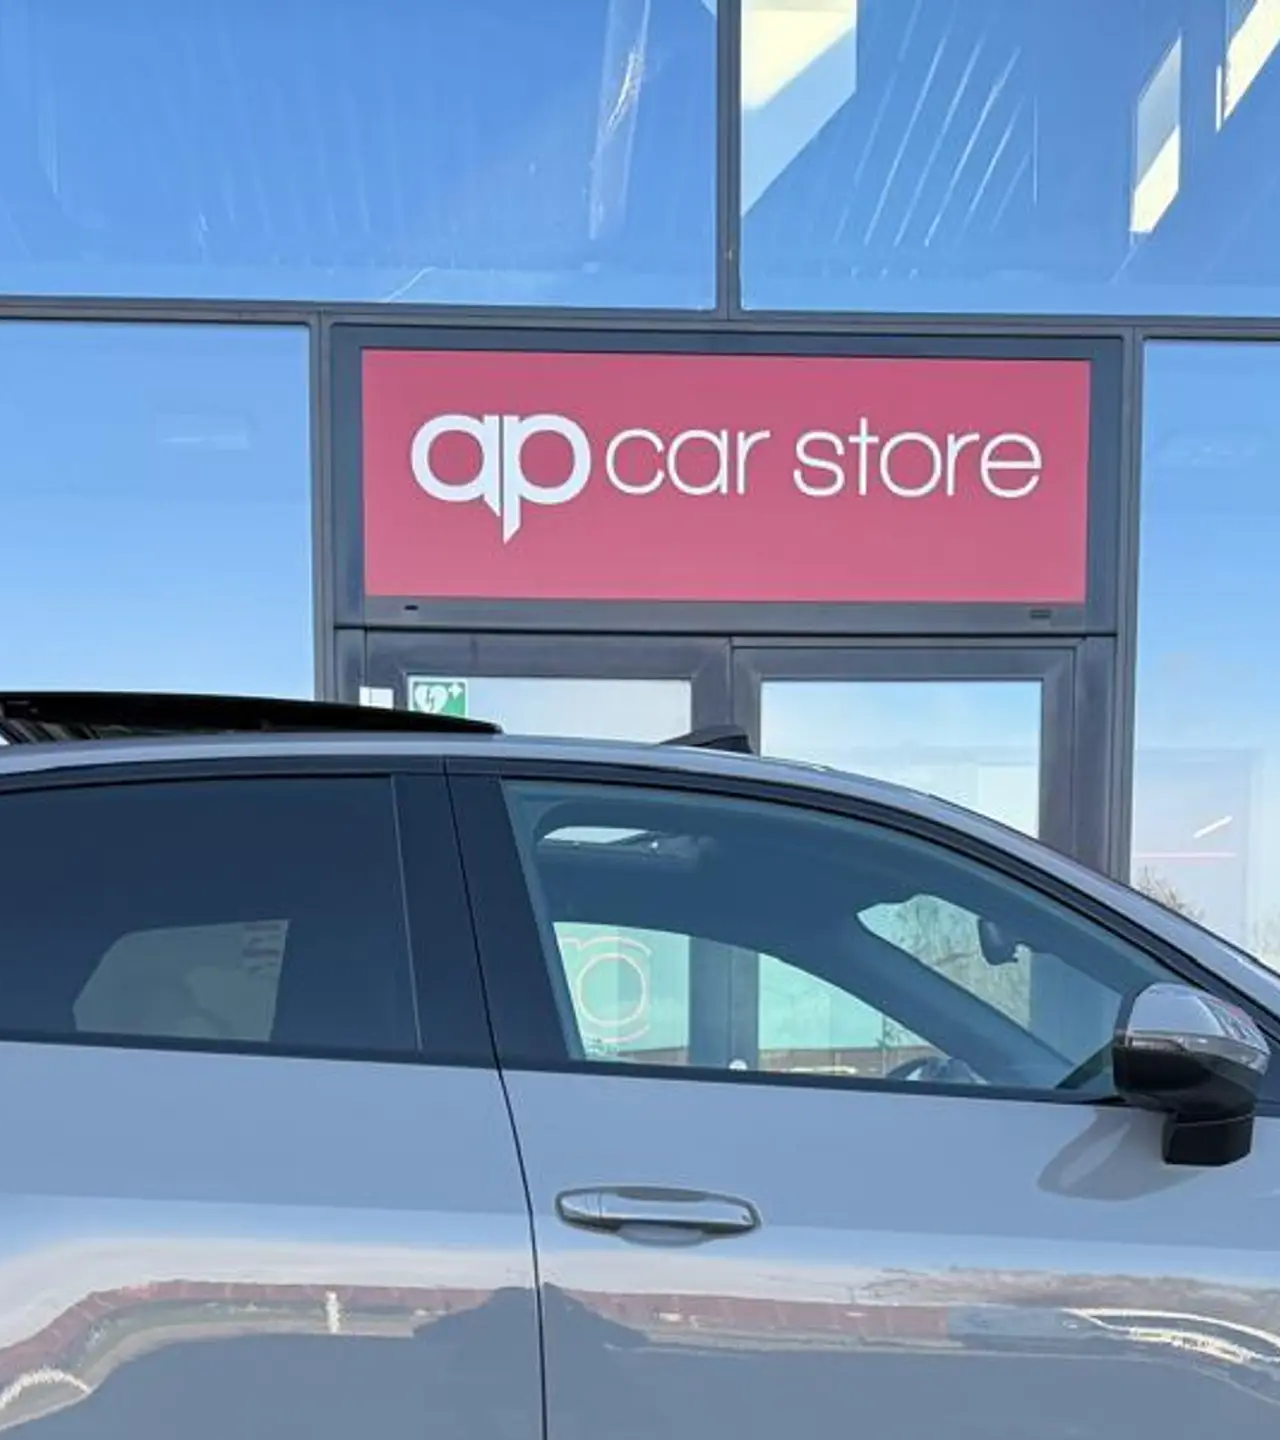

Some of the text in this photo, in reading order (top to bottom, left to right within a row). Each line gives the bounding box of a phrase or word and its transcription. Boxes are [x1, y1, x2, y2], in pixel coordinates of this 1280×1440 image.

[410, 413, 1043, 545] ap car store
